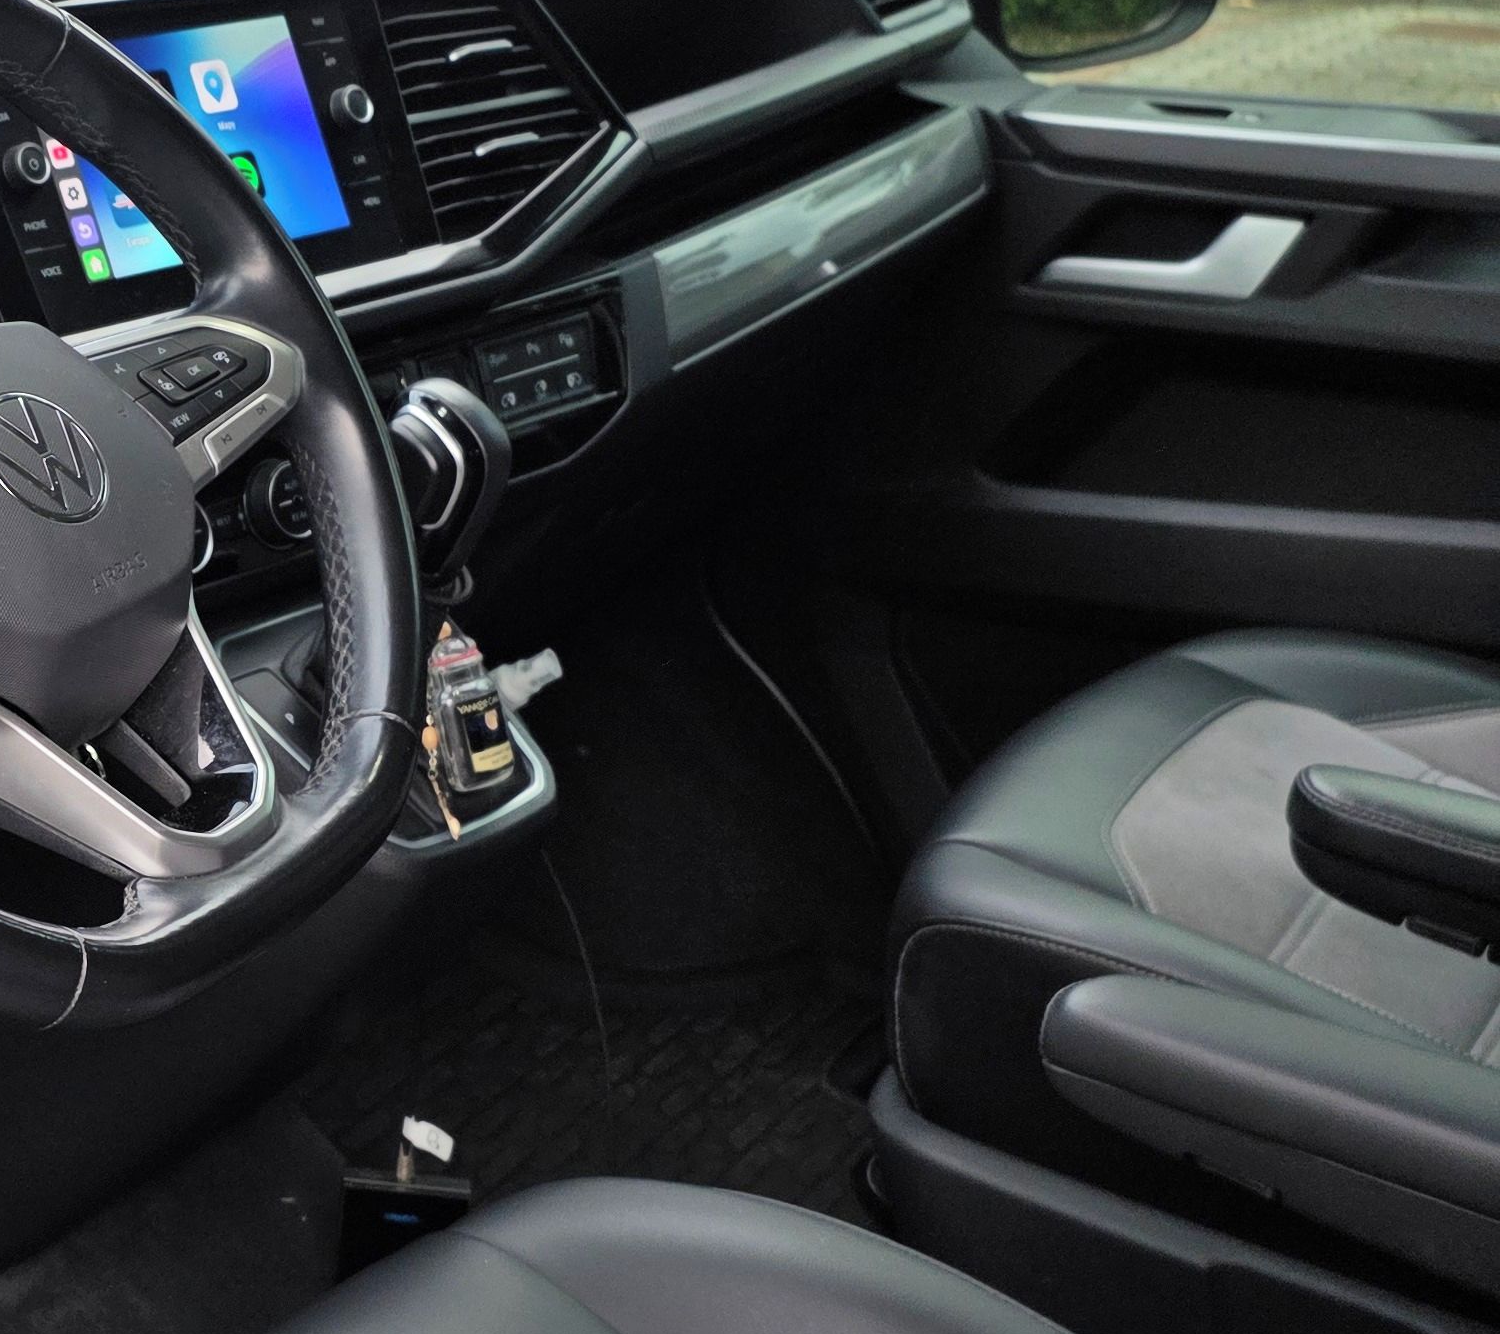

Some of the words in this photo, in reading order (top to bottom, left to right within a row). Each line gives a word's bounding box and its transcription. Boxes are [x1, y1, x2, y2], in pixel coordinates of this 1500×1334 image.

[23, 218, 49, 232] PHONE
[40, 265, 63, 278] VOICE
[187, 364, 202, 376] OK
[171, 412, 191, 429] VIEW
